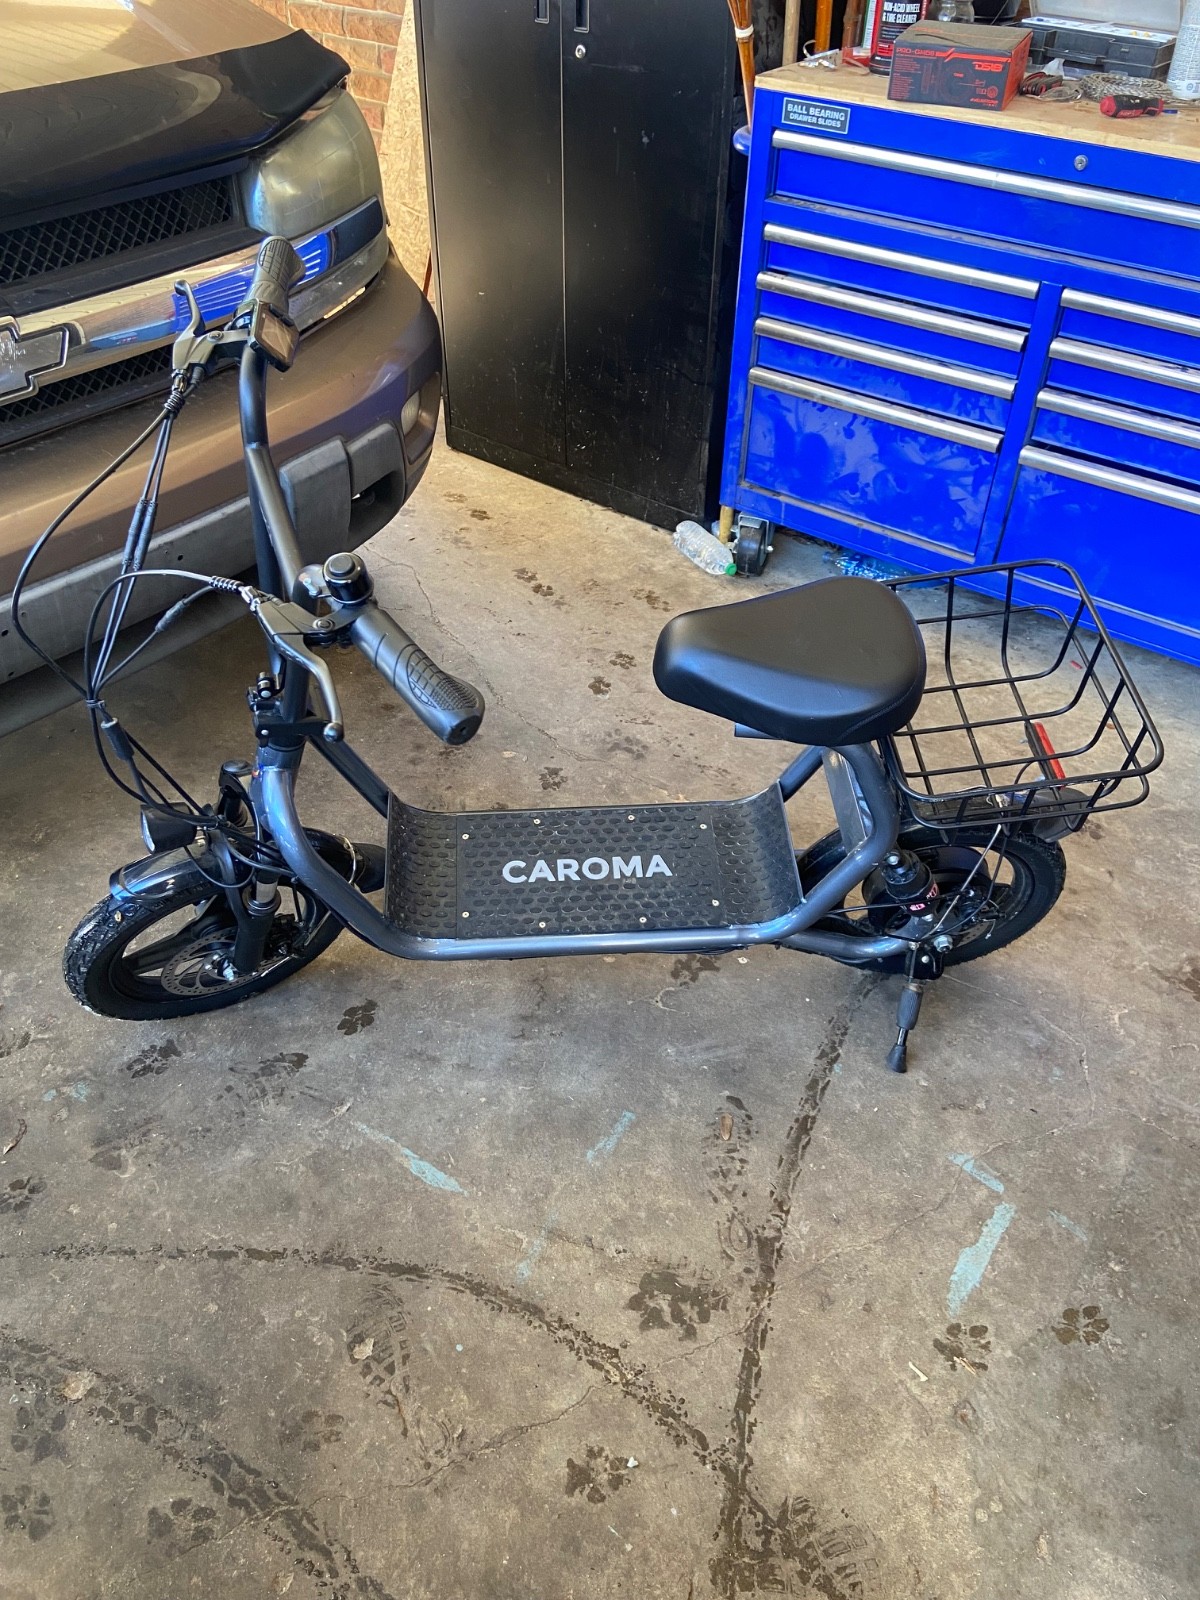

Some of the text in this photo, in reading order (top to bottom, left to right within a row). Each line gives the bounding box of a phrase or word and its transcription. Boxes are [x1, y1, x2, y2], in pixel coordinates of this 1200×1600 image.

[896, 13, 917, 23] CLEANER
[787, 103, 845, 120] BALL BEARING
[789, 113, 841, 127] DRAWER SLIDES
[502, 854, 673, 883] CAROMA
